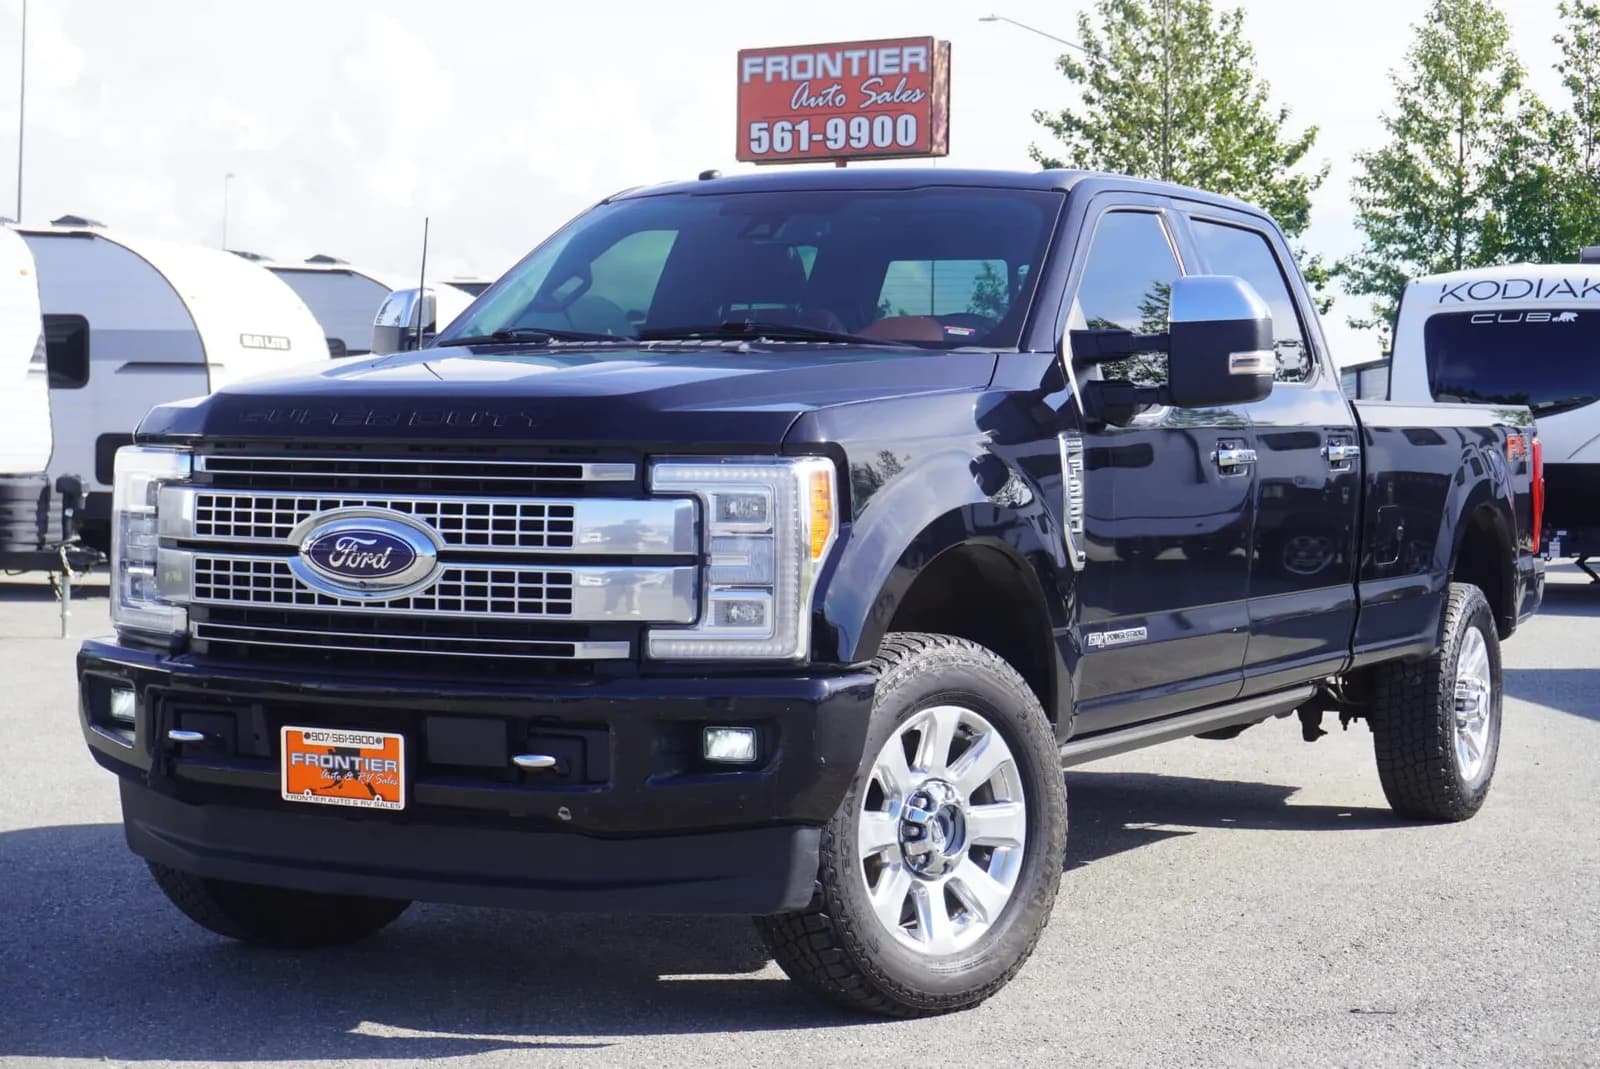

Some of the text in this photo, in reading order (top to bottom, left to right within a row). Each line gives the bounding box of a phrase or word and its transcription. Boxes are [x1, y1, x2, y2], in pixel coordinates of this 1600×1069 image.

[743, 46, 927, 83] FRONTIER
[791, 78, 925, 110] Auto Sales
[750, 114, 917, 154] 561-9900
[1439, 278, 1600, 303] KODIAK
[1471, 312, 1551, 324] CUB
[329, 537, 392, 569] Ford
[291, 752, 397, 773] FRONTIER
[320, 769, 398, 785] Auto & RV Sales
[285, 795, 327, 803] FRONTIER
